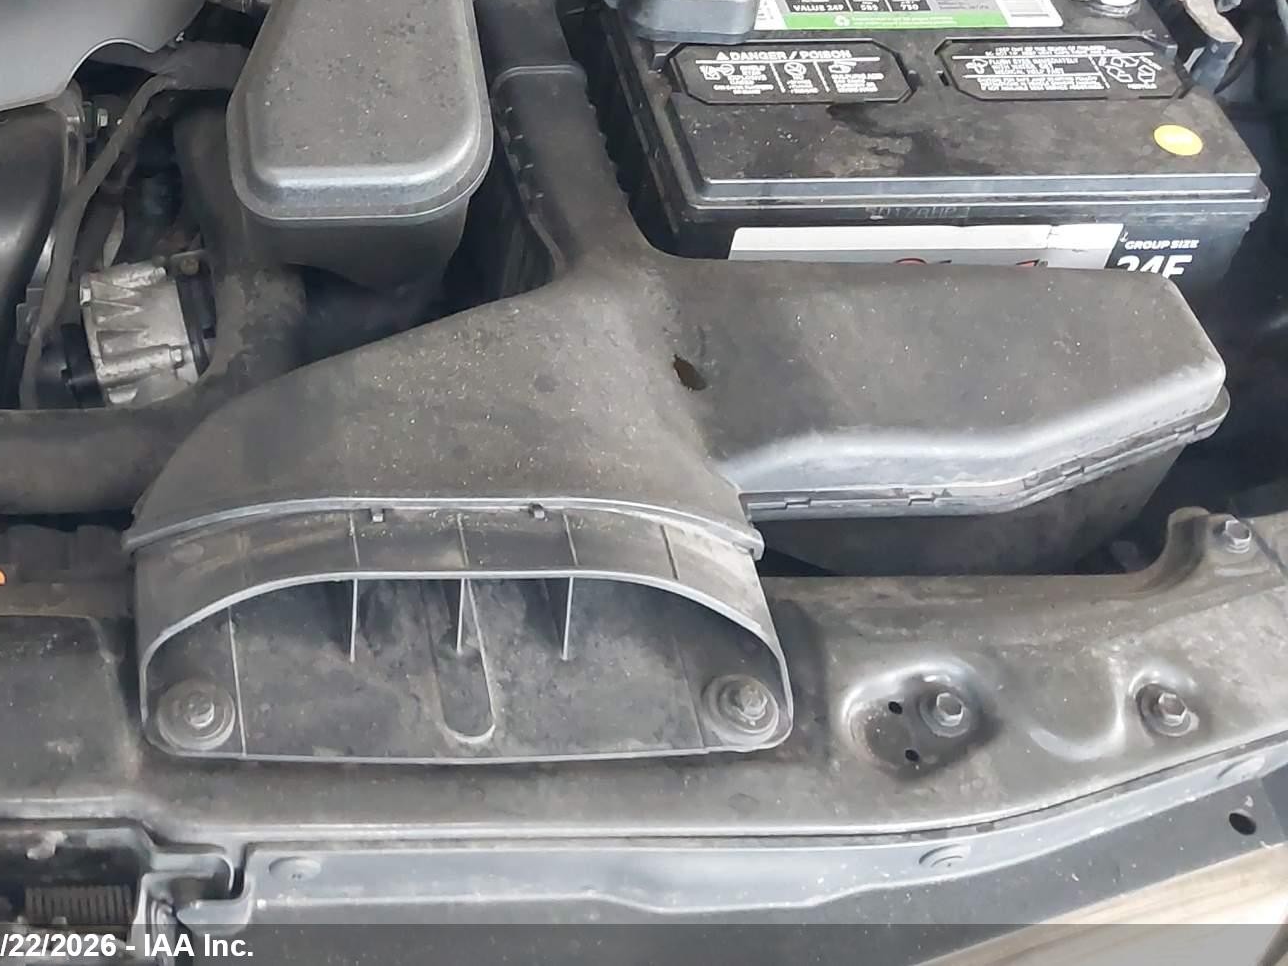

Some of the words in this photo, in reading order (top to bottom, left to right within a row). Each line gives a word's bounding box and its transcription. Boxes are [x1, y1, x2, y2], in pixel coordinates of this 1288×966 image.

[792, 3, 825, 12] VALUE
[729, 50, 788, 61] DANGER
[799, 49, 853, 59] POISON
[1124, 240, 1171, 250] GROUP
[1170, 239, 1200, 249] SIZE
